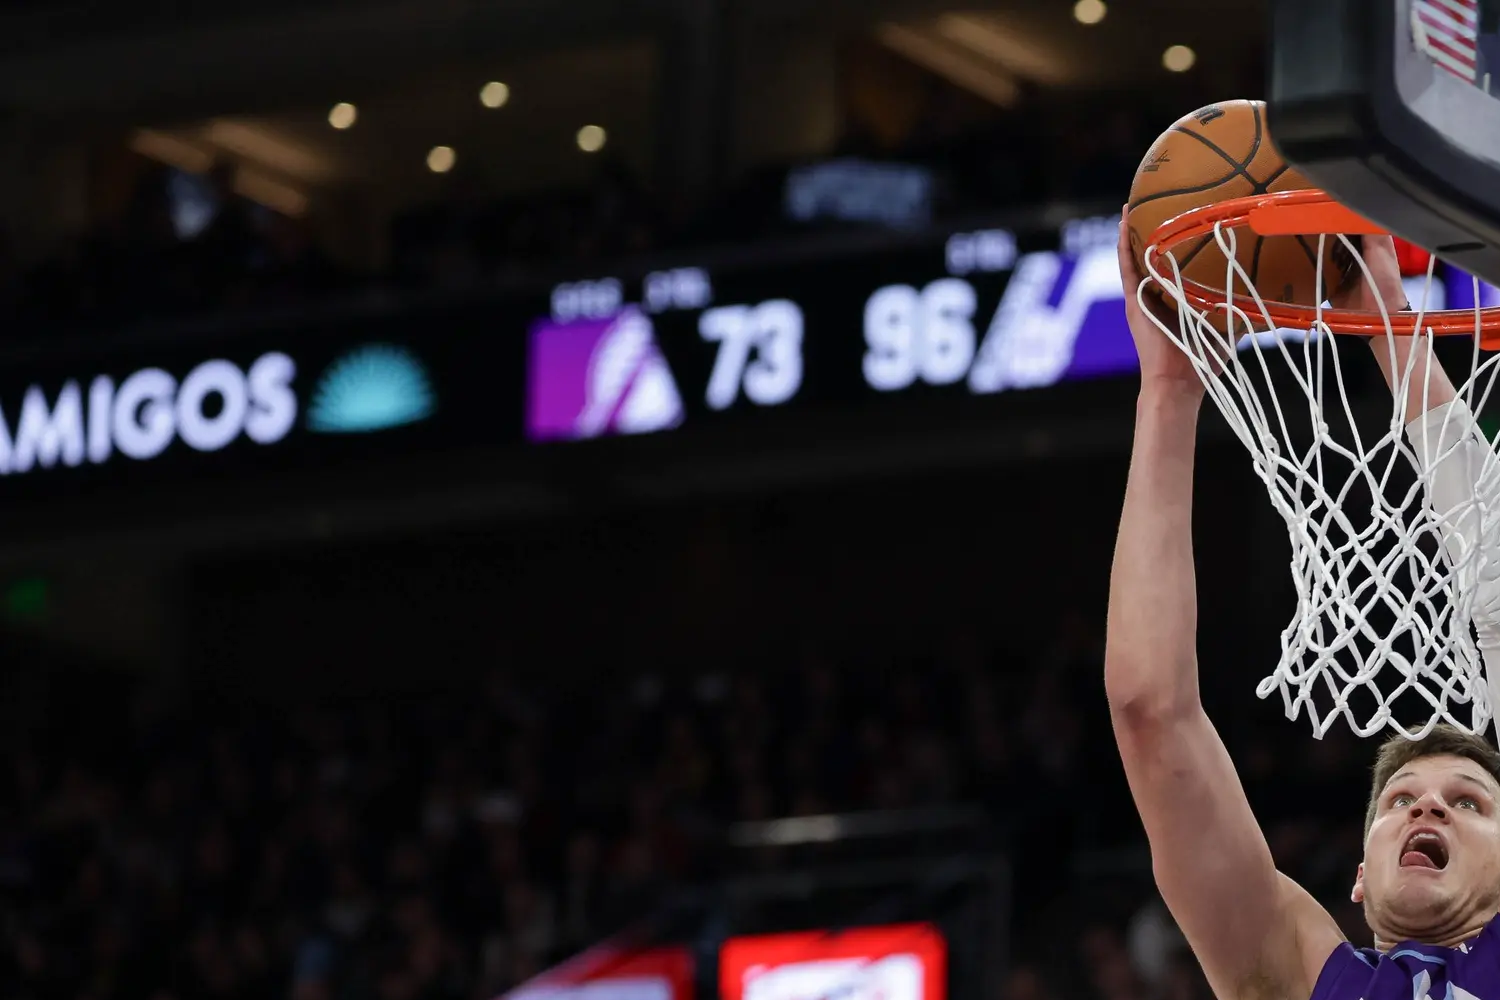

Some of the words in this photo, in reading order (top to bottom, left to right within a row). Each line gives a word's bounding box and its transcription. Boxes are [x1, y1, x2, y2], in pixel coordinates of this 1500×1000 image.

[697, 298, 805, 411] 73
[862, 283, 977, 392] 96
[0, 350, 298, 475] MIGOS
